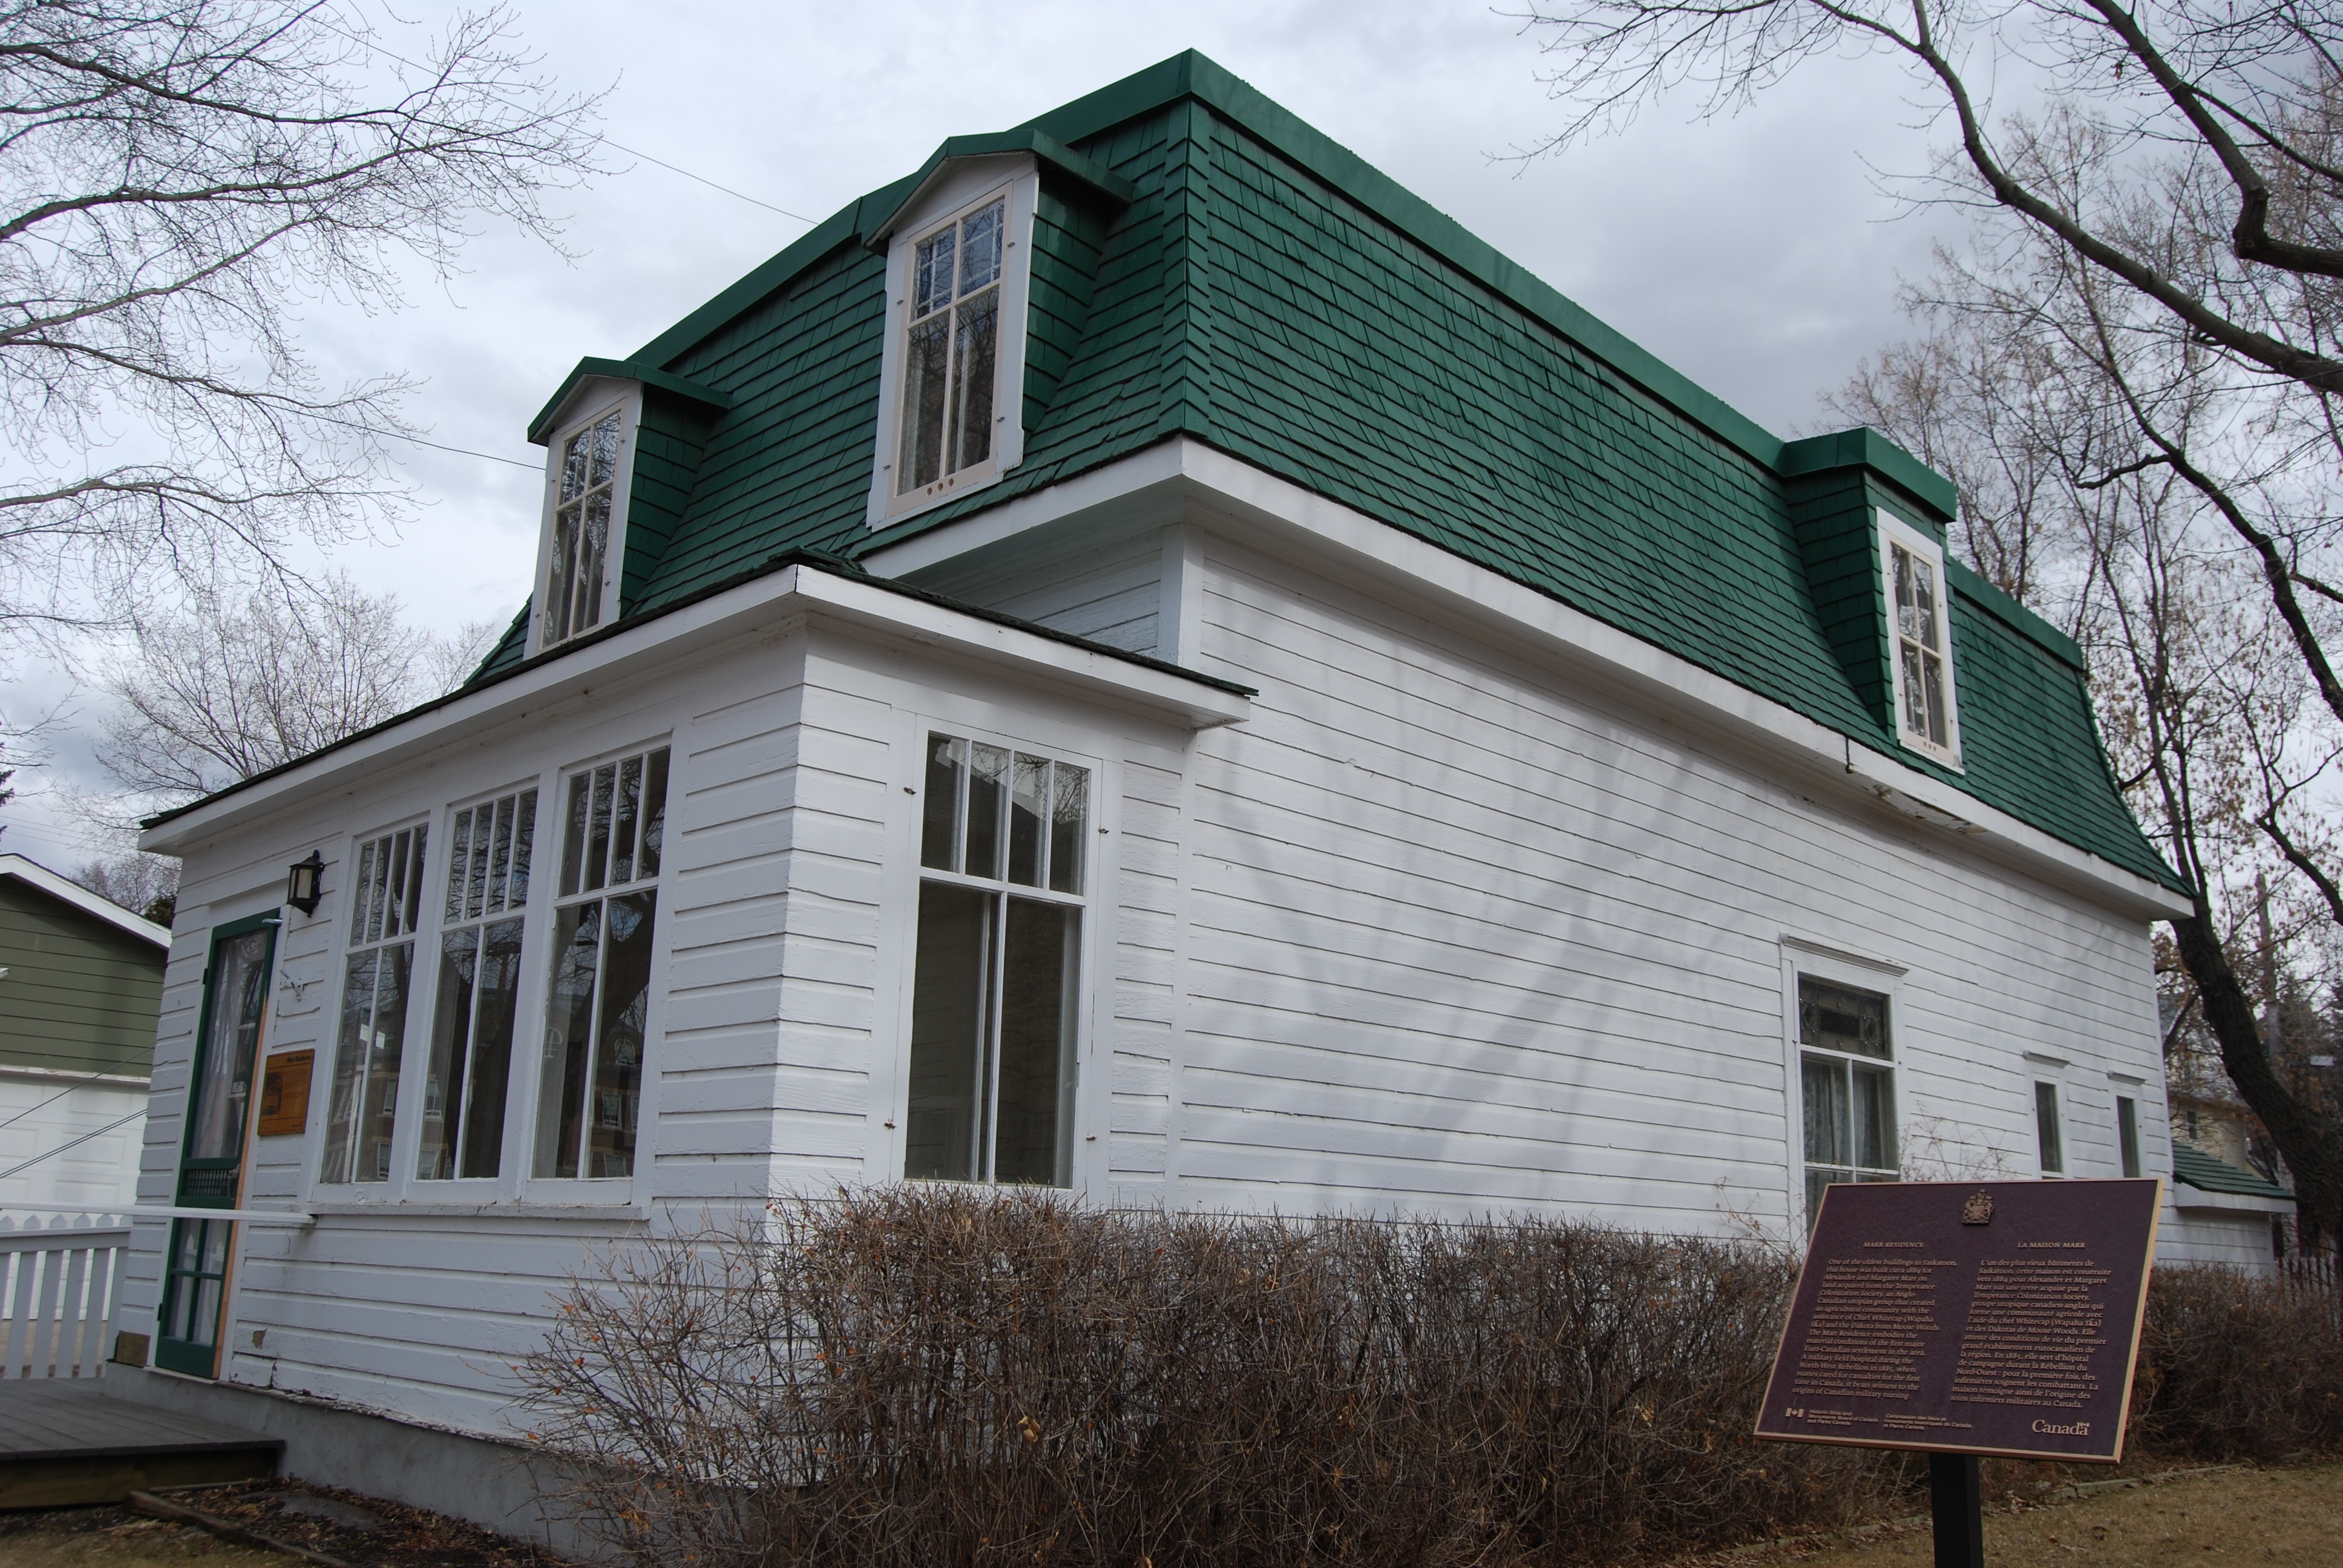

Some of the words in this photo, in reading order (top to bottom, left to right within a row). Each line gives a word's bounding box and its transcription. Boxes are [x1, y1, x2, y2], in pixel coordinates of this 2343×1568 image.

[2016, 1317, 2050, 1325] Whitecap
[2051, 1318, 2083, 1327] (Wapaha
[1984, 1342, 2032, 1350] établissement
[2040, 1362, 2074, 1370] Rébellion
[1956, 1367, 1996, 1375] Nord-Ouest
[1955, 1376, 1991, 1384] infirmières
[1979, 1386, 2013, 1395] témoigne
[2006, 1397, 2040, 1405] militaires
[2032, 1420, 2089, 1435] Canada
